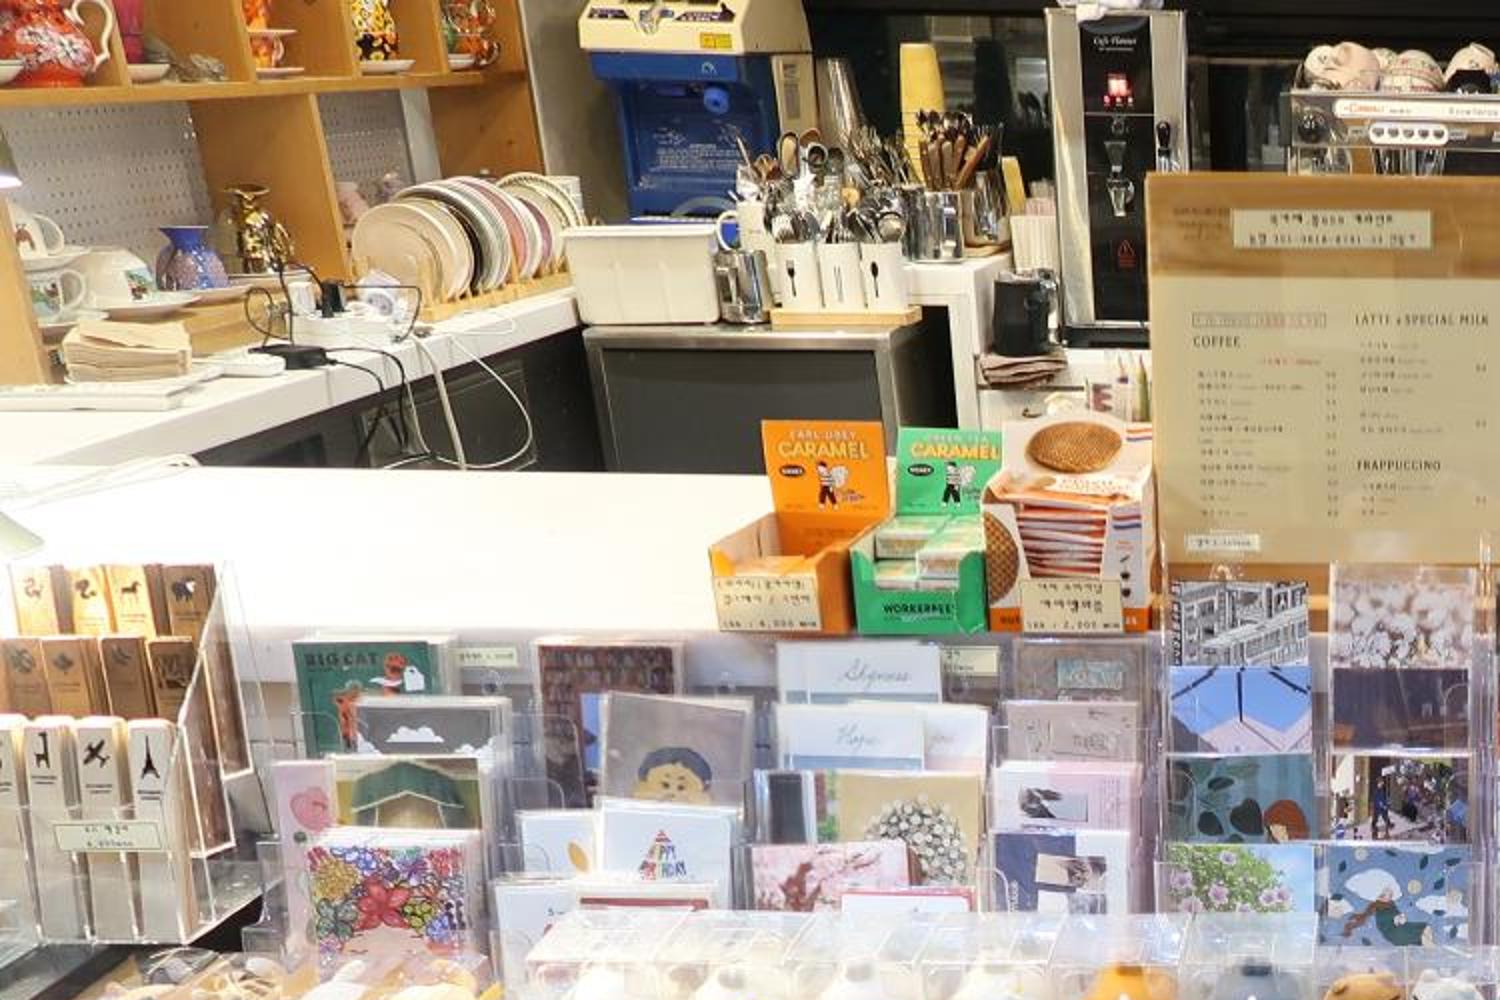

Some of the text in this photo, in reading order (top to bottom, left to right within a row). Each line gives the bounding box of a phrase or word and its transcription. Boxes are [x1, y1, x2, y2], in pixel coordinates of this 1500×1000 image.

[1404, 313, 1455, 327] SPECIAL
[1459, 314, 1490, 327] MILK
[1193, 335, 1242, 349] COFFEE
[777, 442, 868, 460] CARAMEL
[910, 443, 1000, 461] CARAMEL
[1357, 460, 1443, 472] FRAPPUCCINO
[343, 652, 377, 666] CAT
